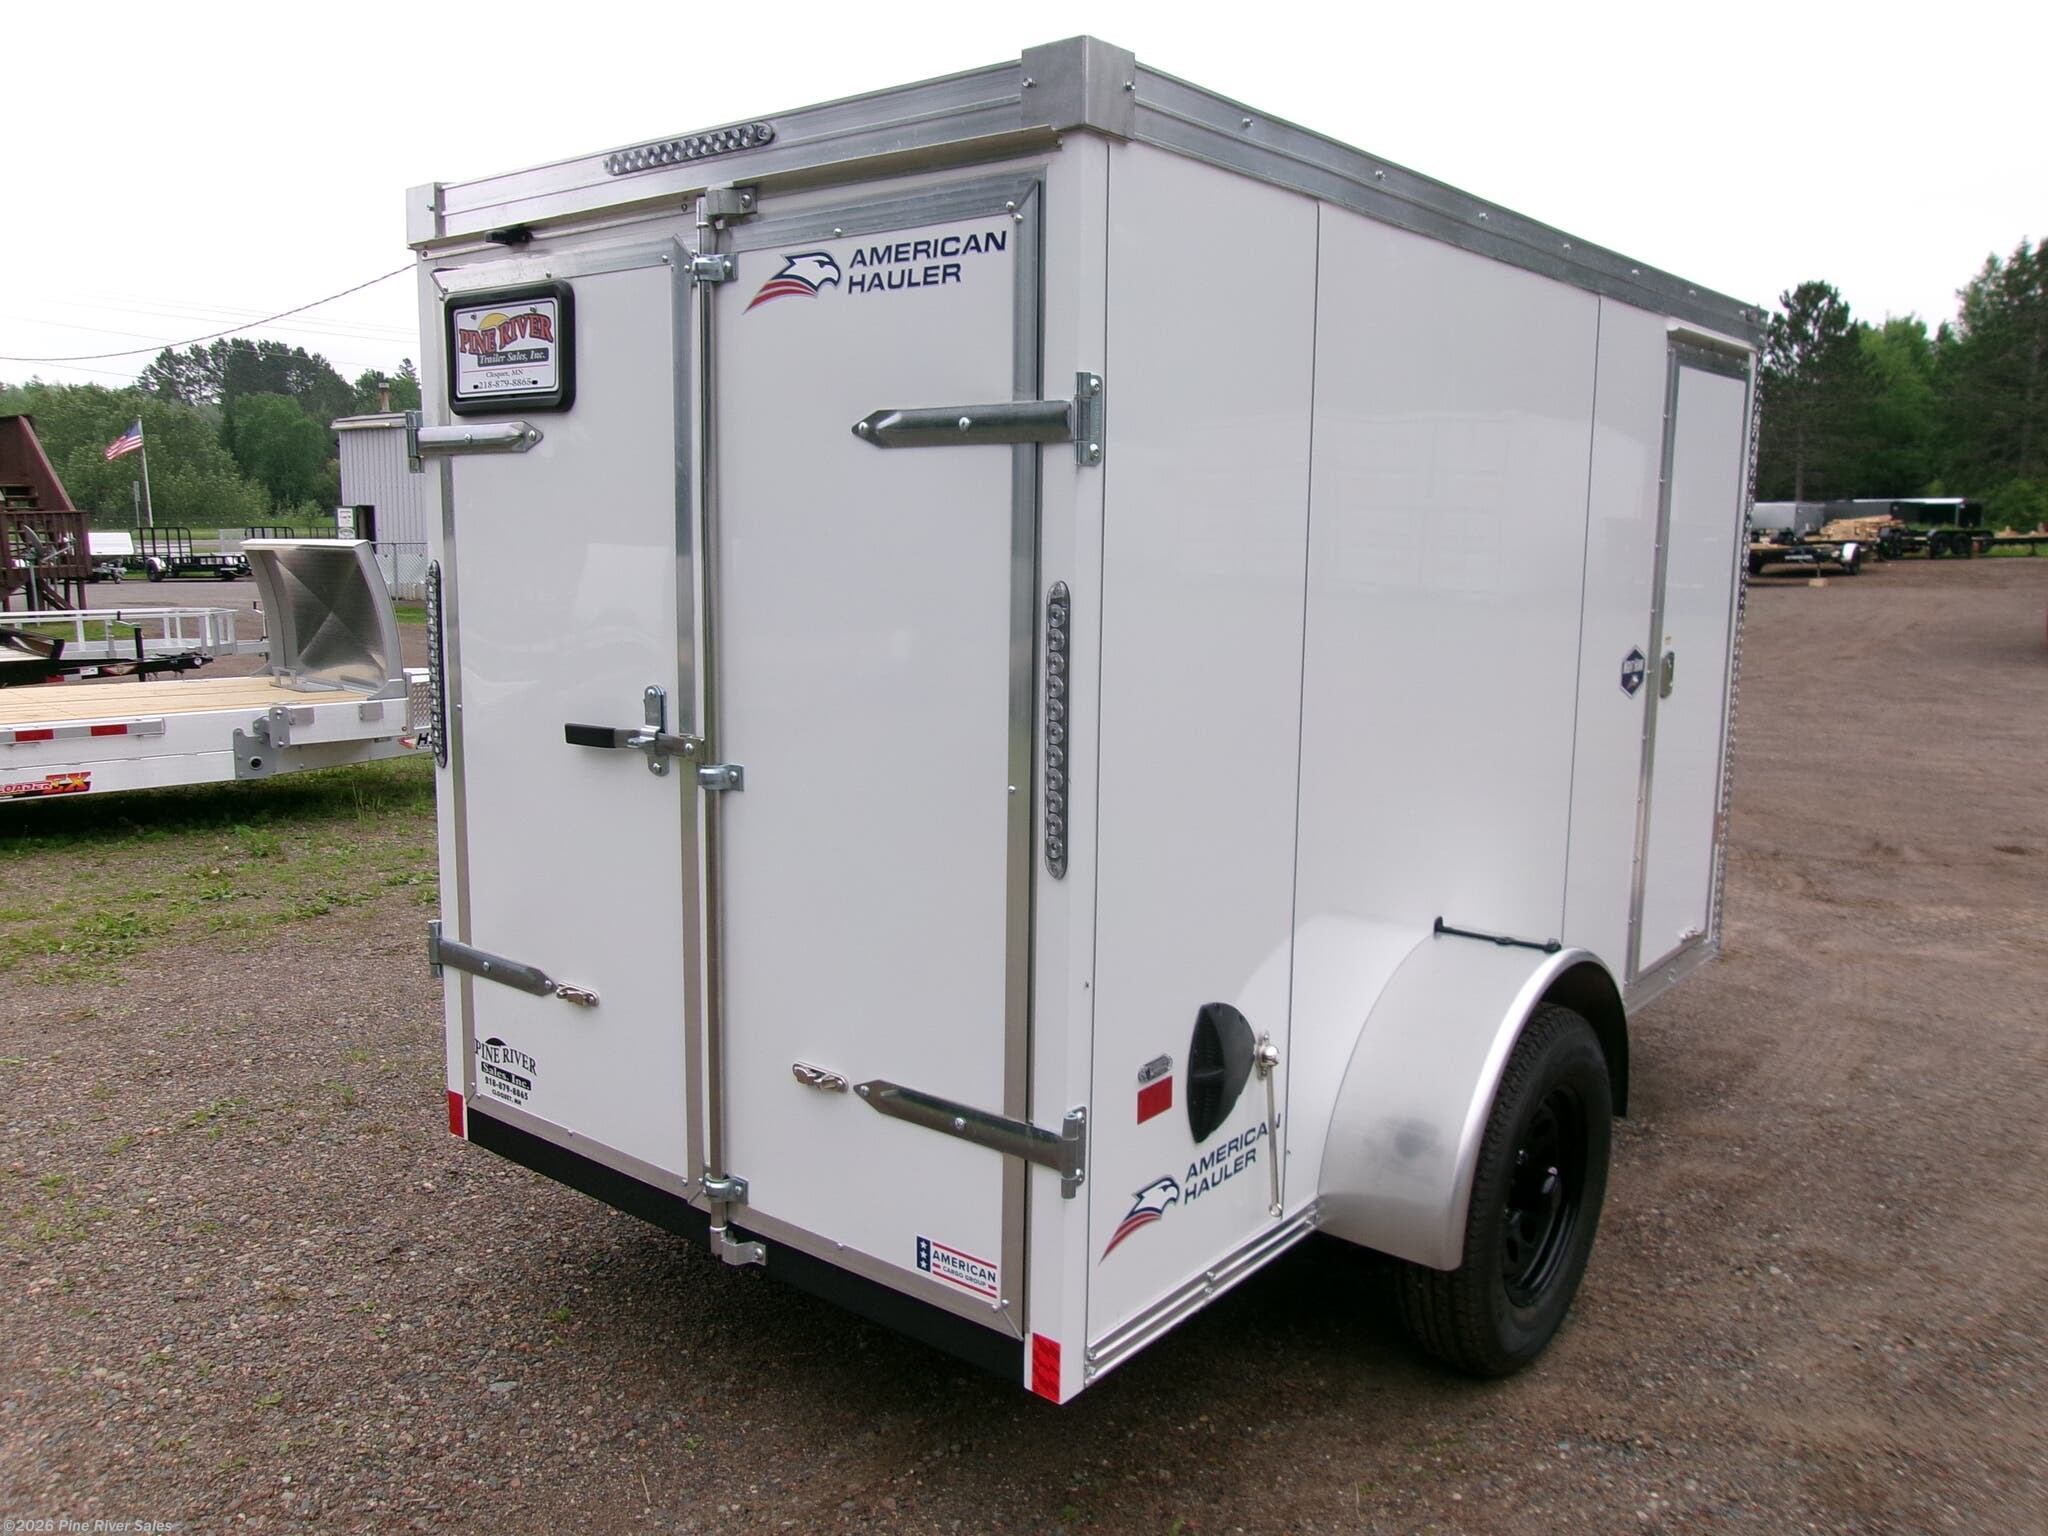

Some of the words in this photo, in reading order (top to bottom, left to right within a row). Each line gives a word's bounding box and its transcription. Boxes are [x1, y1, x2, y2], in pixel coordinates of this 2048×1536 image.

[849, 230, 1008, 269] AMERICAN
[848, 263, 962, 294] HAULER
[459, 328, 497, 356] PINE
[498, 313, 554, 350] RIVER
[480, 354, 505, 365] Trailer
[507, 351, 528, 362] Sales,
[530, 350, 546, 360] Inc.
[475, 1038, 500, 1064] PINE
[502, 1047, 537, 1076] RIVER
[511, 1073, 530, 1090] Inc.
[1184, 1148, 1257, 1205] HAULER
[932, 1250, 997, 1283] AMERICAN
[942, 1266, 964, 1279] CARGO
[965, 1275, 987, 1288] GROUP
